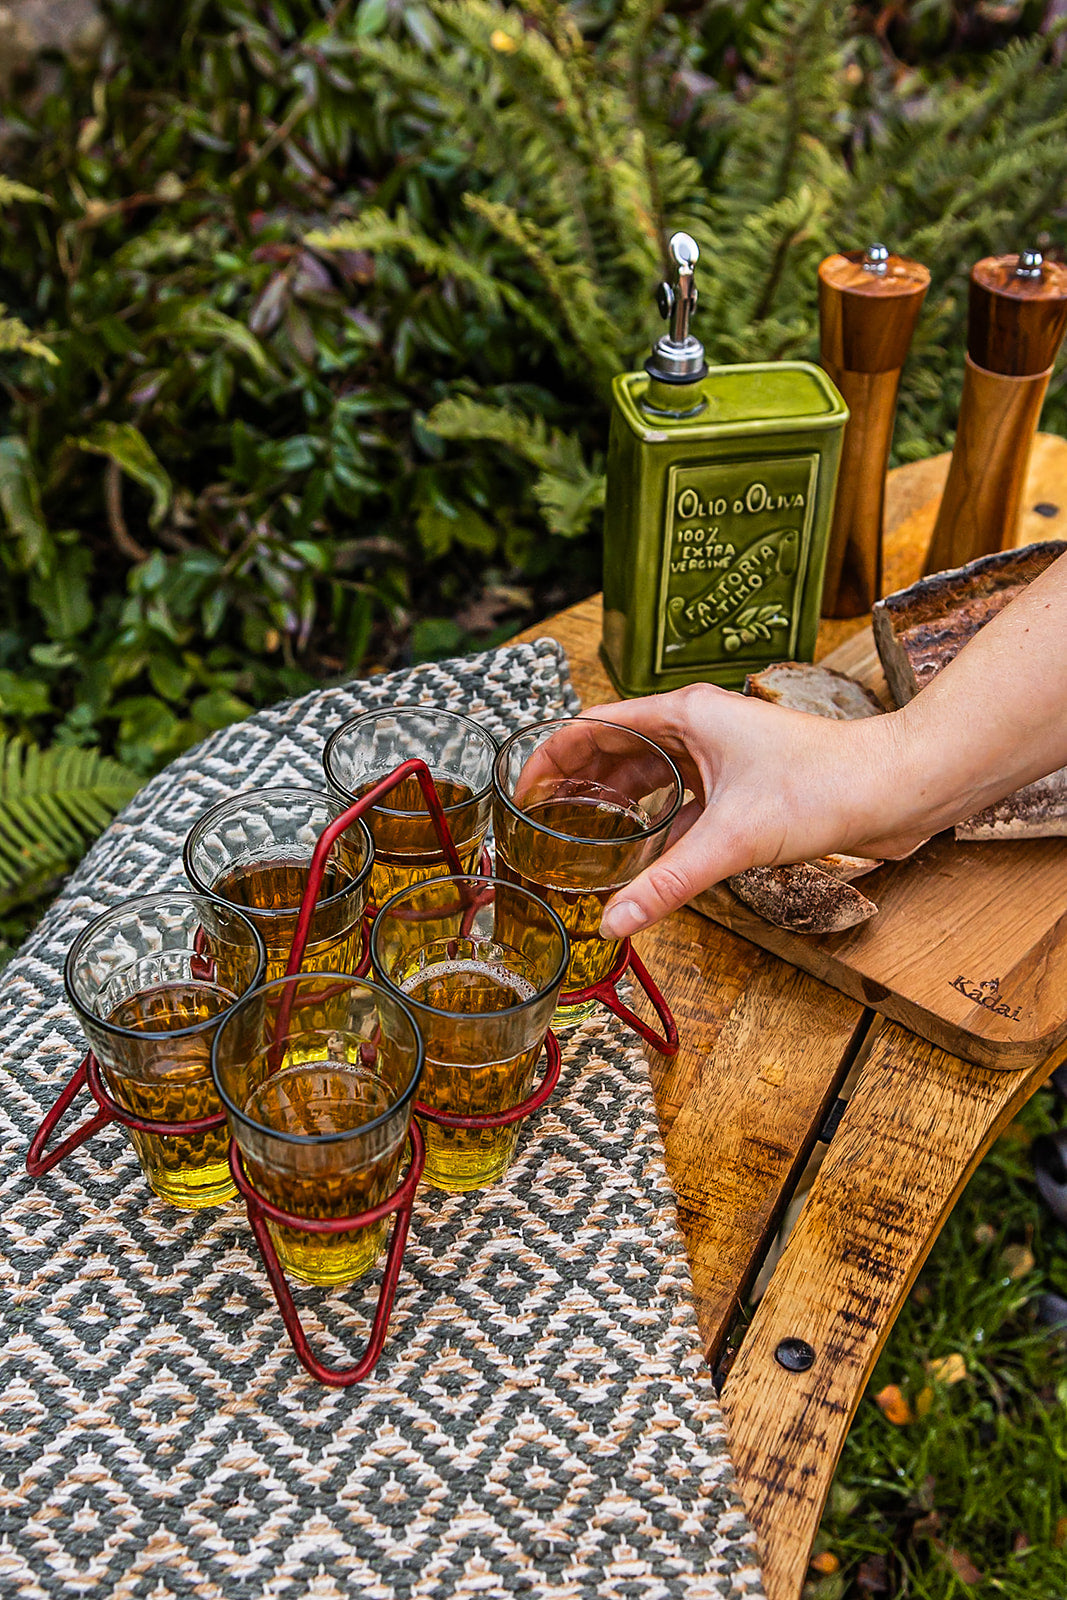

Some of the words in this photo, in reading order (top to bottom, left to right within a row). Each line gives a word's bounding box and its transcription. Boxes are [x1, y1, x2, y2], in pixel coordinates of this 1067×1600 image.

[678, 527, 719, 546] 100%
[683, 543, 735, 559] EXTRA
[671, 556, 733, 573] VERGINE
[685, 545, 775, 620] FATTORIA
